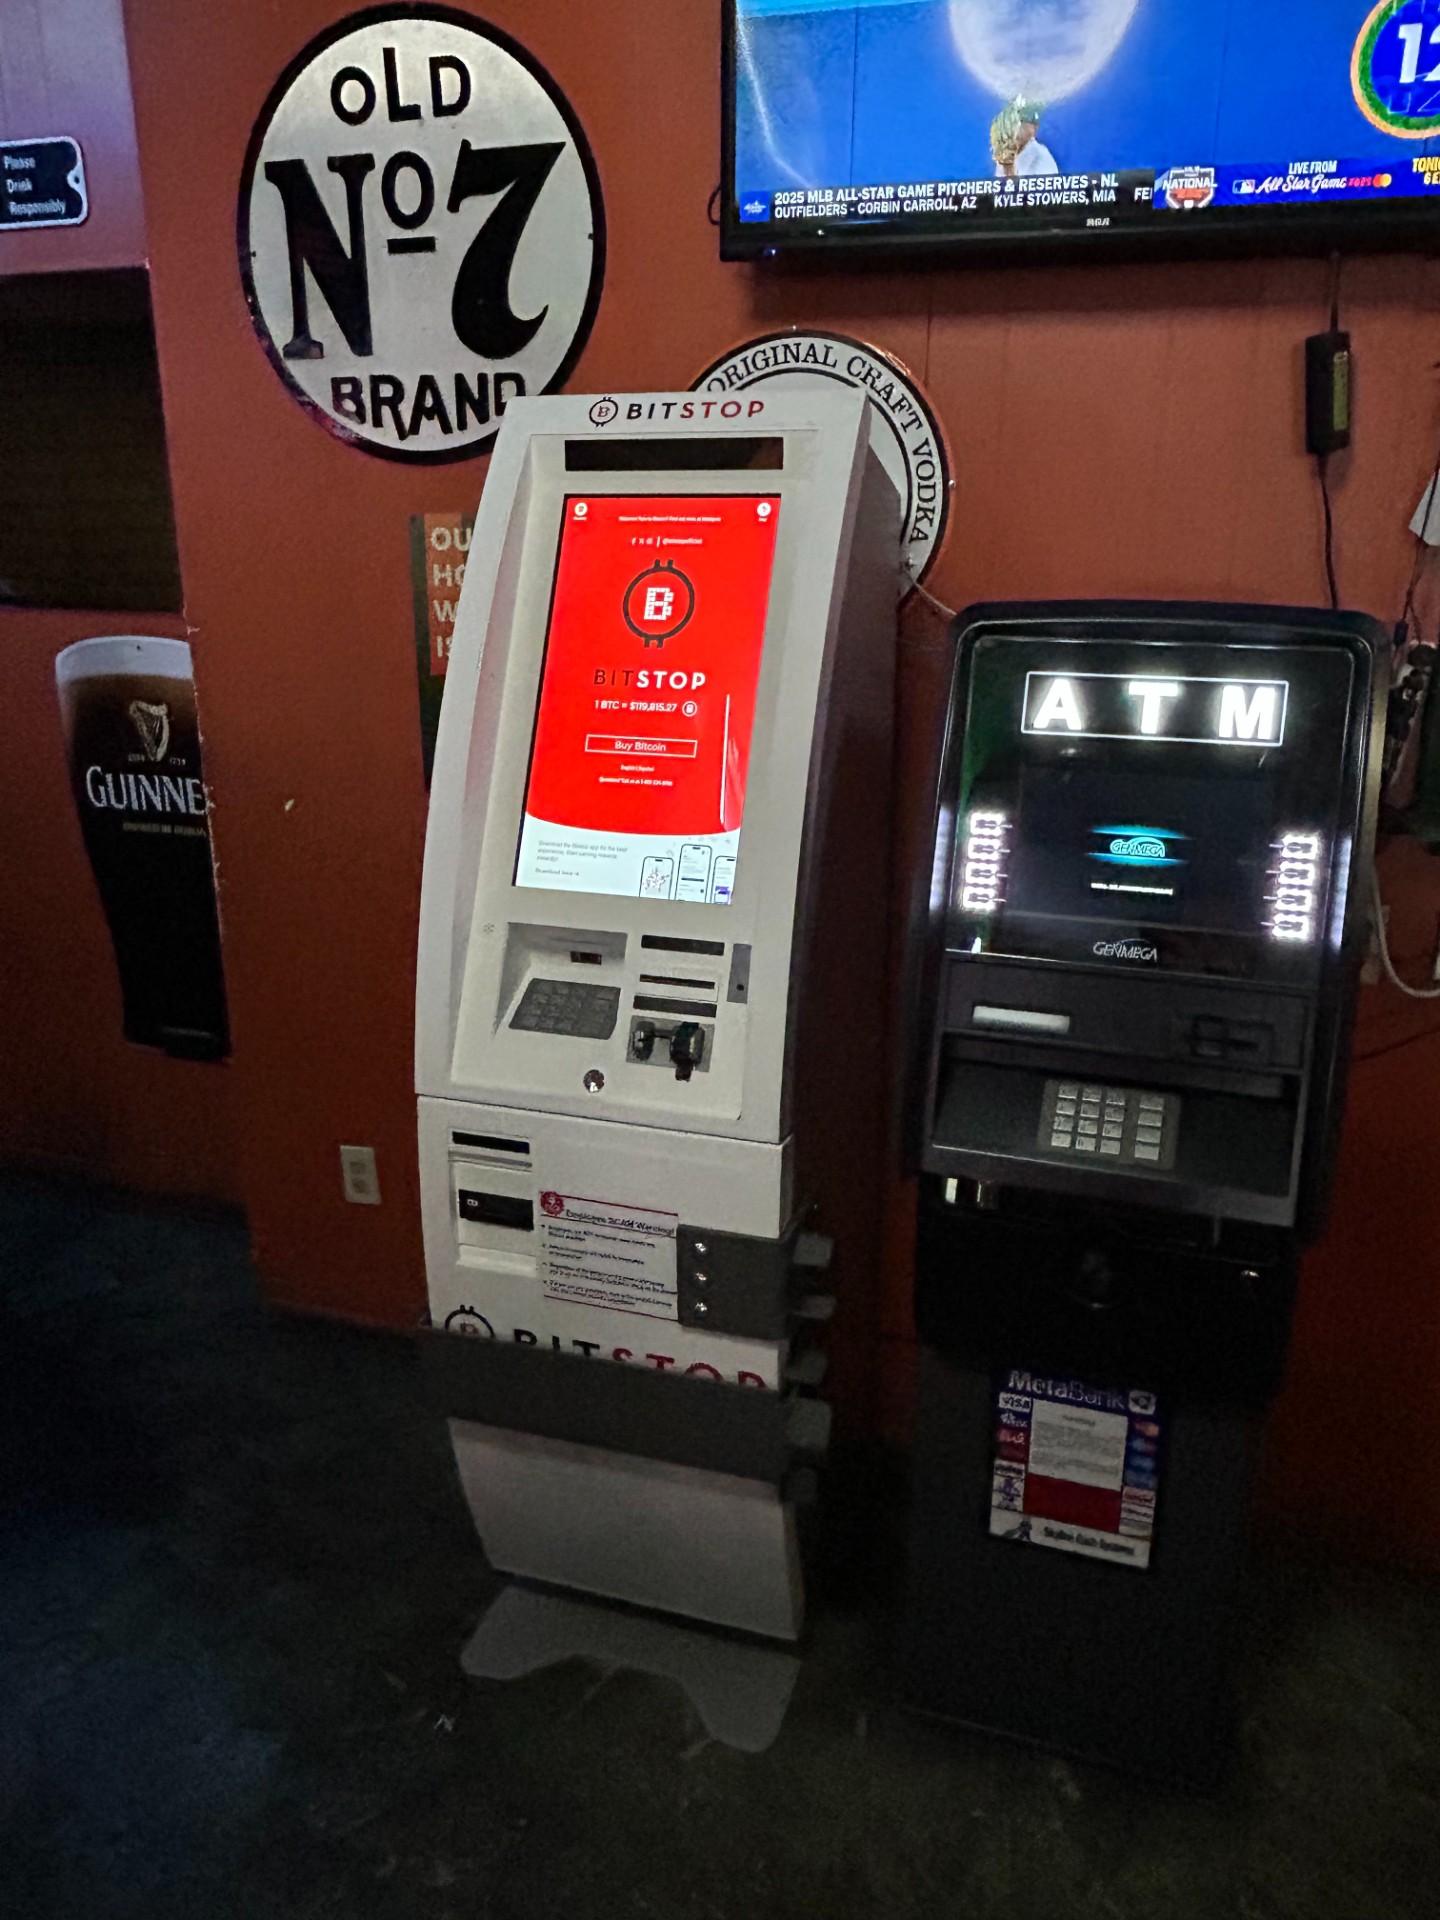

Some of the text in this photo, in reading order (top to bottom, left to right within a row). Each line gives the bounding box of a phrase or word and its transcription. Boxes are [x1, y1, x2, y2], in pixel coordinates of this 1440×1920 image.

[331, 47, 471, 125] OLD
[1288, 160, 1338, 175] LIVE FROM
[774, 191, 805, 205] 2025
[807, 190, 833, 203] MLB
[836, 186, 894, 201] ALL-STAR
[897, 182, 935, 198] GAME
[937, 180, 1001, 196] PITCHERS
[1004, 179, 1015, 192] &
[1018, 175, 1089, 191] RESERVES
[1101, 173, 1119, 188] NL
[1162, 176, 1218, 191] NATIONAL
[774, 203, 848, 219] OUTFIELDERS
[857, 200, 900, 214] CORBIN
[903, 198, 958, 213] CARROLL,
[961, 196, 977, 209] AZ
[993, 188, 1116, 208] KYLE STOWERS, MIA
[331, 372, 526, 440] BRAND
[627, 400, 765, 420] BITSTOP
[706, 343, 937, 545] ORIGINAL CRAFT VODKA
[593, 669, 706, 690] BITSTOP
[600, 700, 620, 710] BTC
[1031, 678, 1276, 740] ATM
[614, 739, 666, 752] Buy Bitcoin
